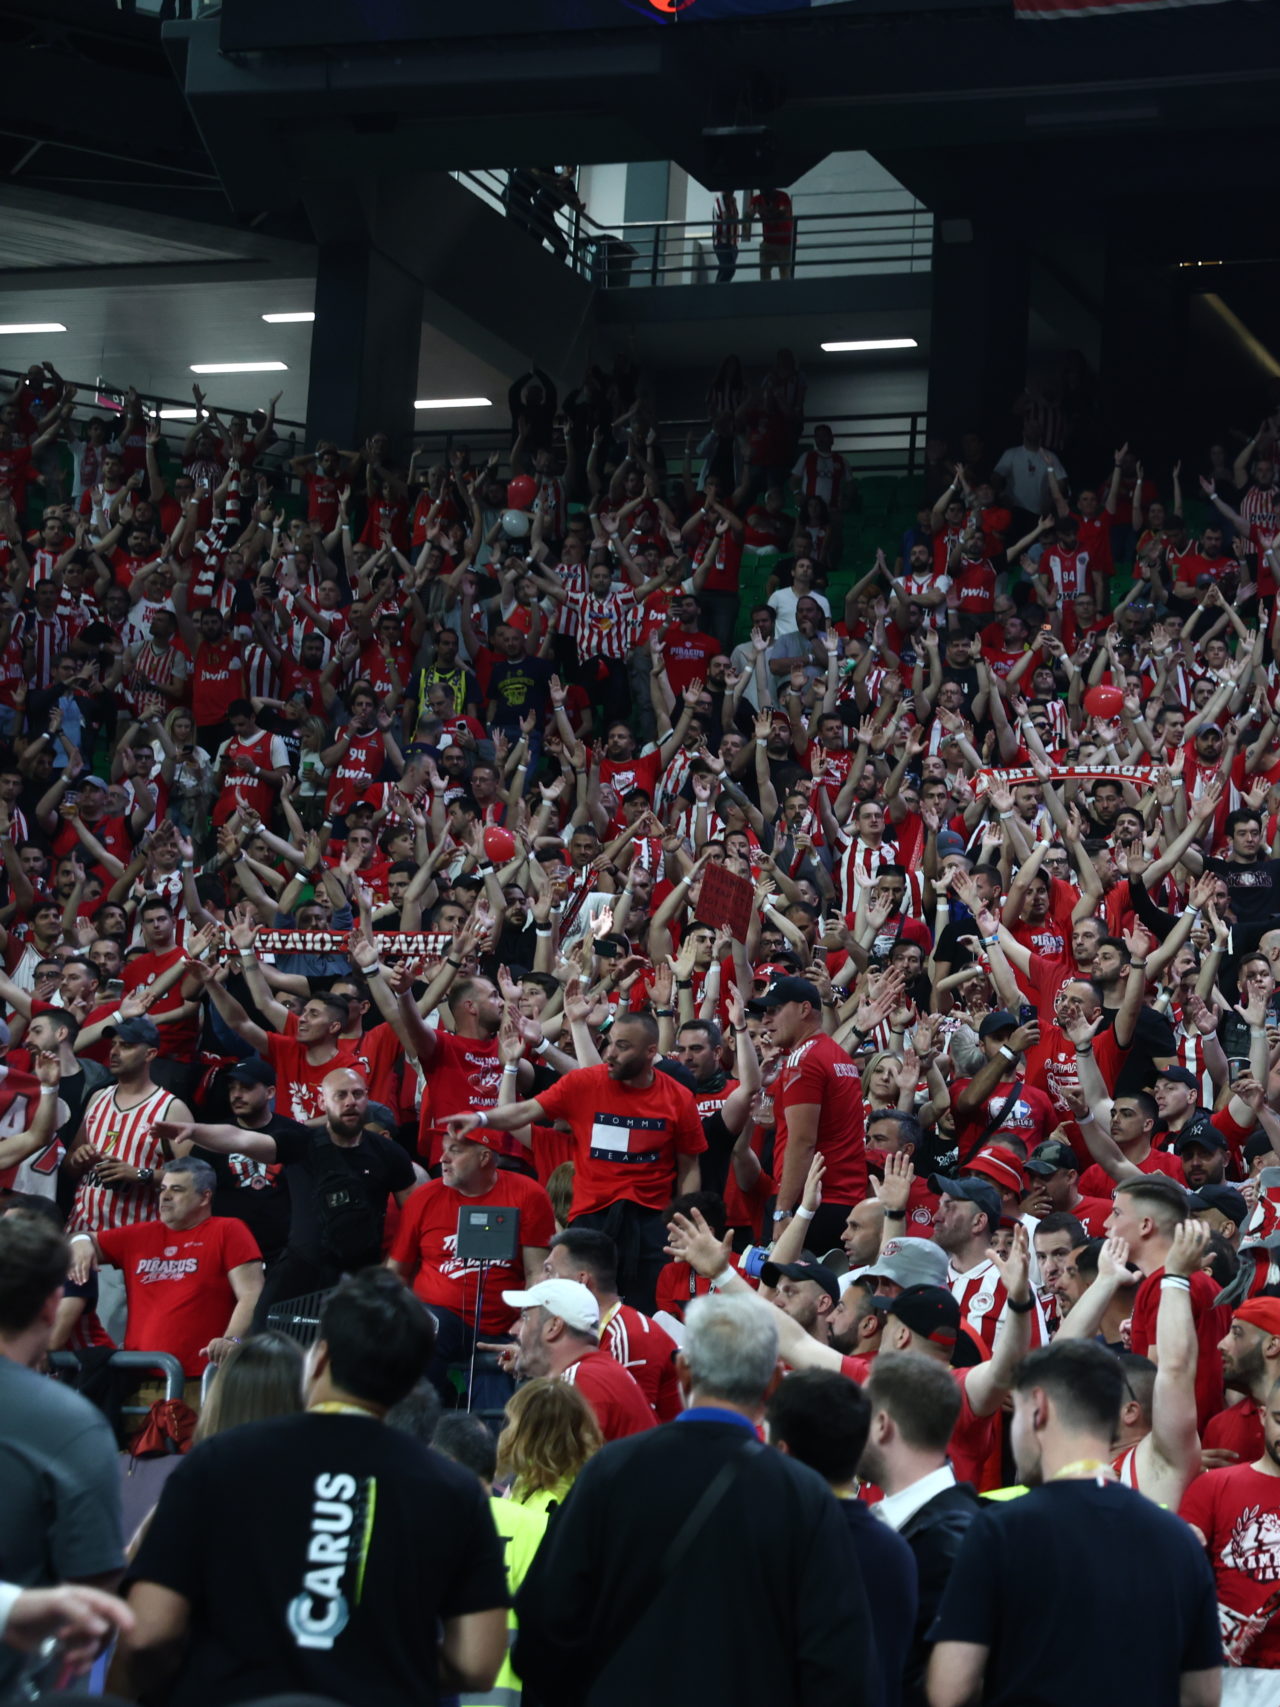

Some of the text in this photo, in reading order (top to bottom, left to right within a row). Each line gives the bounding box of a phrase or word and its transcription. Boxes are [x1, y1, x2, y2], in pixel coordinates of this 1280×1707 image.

[959, 587, 990, 600] bwin
[201, 670, 230, 682] bwin
[349, 747, 366, 763] 94
[224, 774, 260, 789] bwin
[336, 766, 373, 782] bwin
[599, 1113, 664, 1128] TOMMY
[106, 1130, 119, 1153] 7
[594, 1150, 658, 1162] JEANS
[135, 1257, 199, 1276] PIRAEUS
[288, 1472, 358, 1651] ICARUS
